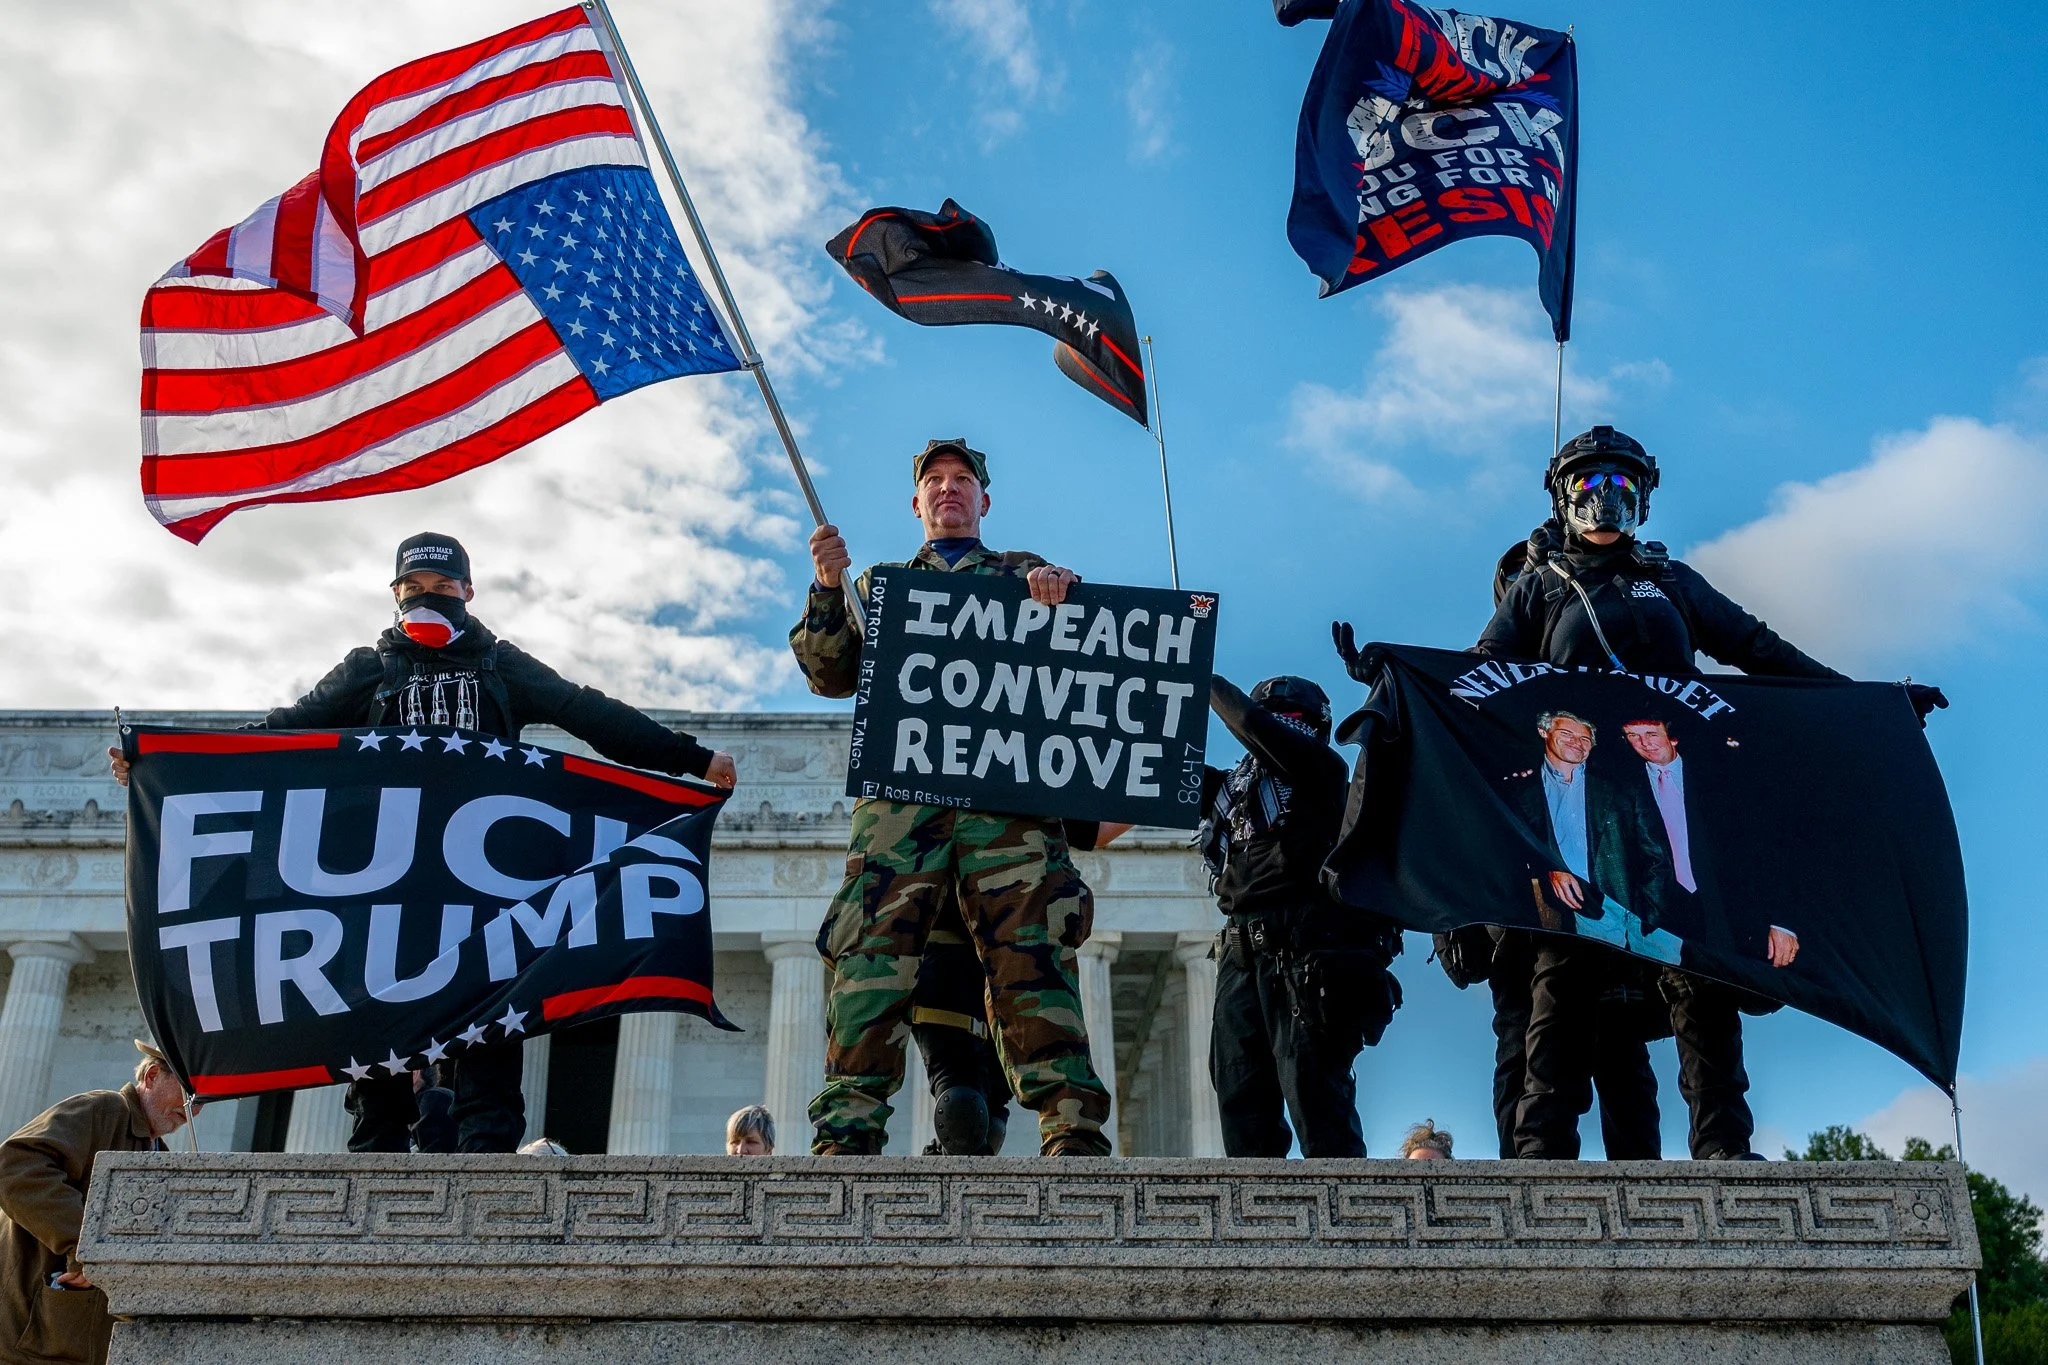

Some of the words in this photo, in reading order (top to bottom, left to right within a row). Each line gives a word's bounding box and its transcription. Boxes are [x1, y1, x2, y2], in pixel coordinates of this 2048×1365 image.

[1431, 147, 1530, 168] FOR
[1435, 167, 1534, 188] FOR
[404, 553, 428, 565] AMERICA
[429, 553, 449, 562] GREAT
[436, 546, 454, 555] MAKE
[864, 576, 888, 649] FOXTROT
[904, 588, 1197, 665] IMPEACH
[857, 659, 876, 706] DELTA
[897, 652, 1195, 739] CONVICT
[849, 718, 868, 770] TANGO
[892, 717, 1164, 798] REMOVE
[884, 785, 910, 801] ROB
[914, 790, 972, 808] RESISTS
[1177, 742, 1204, 805] 8647
[158, 864, 705, 1033] TRUMP
